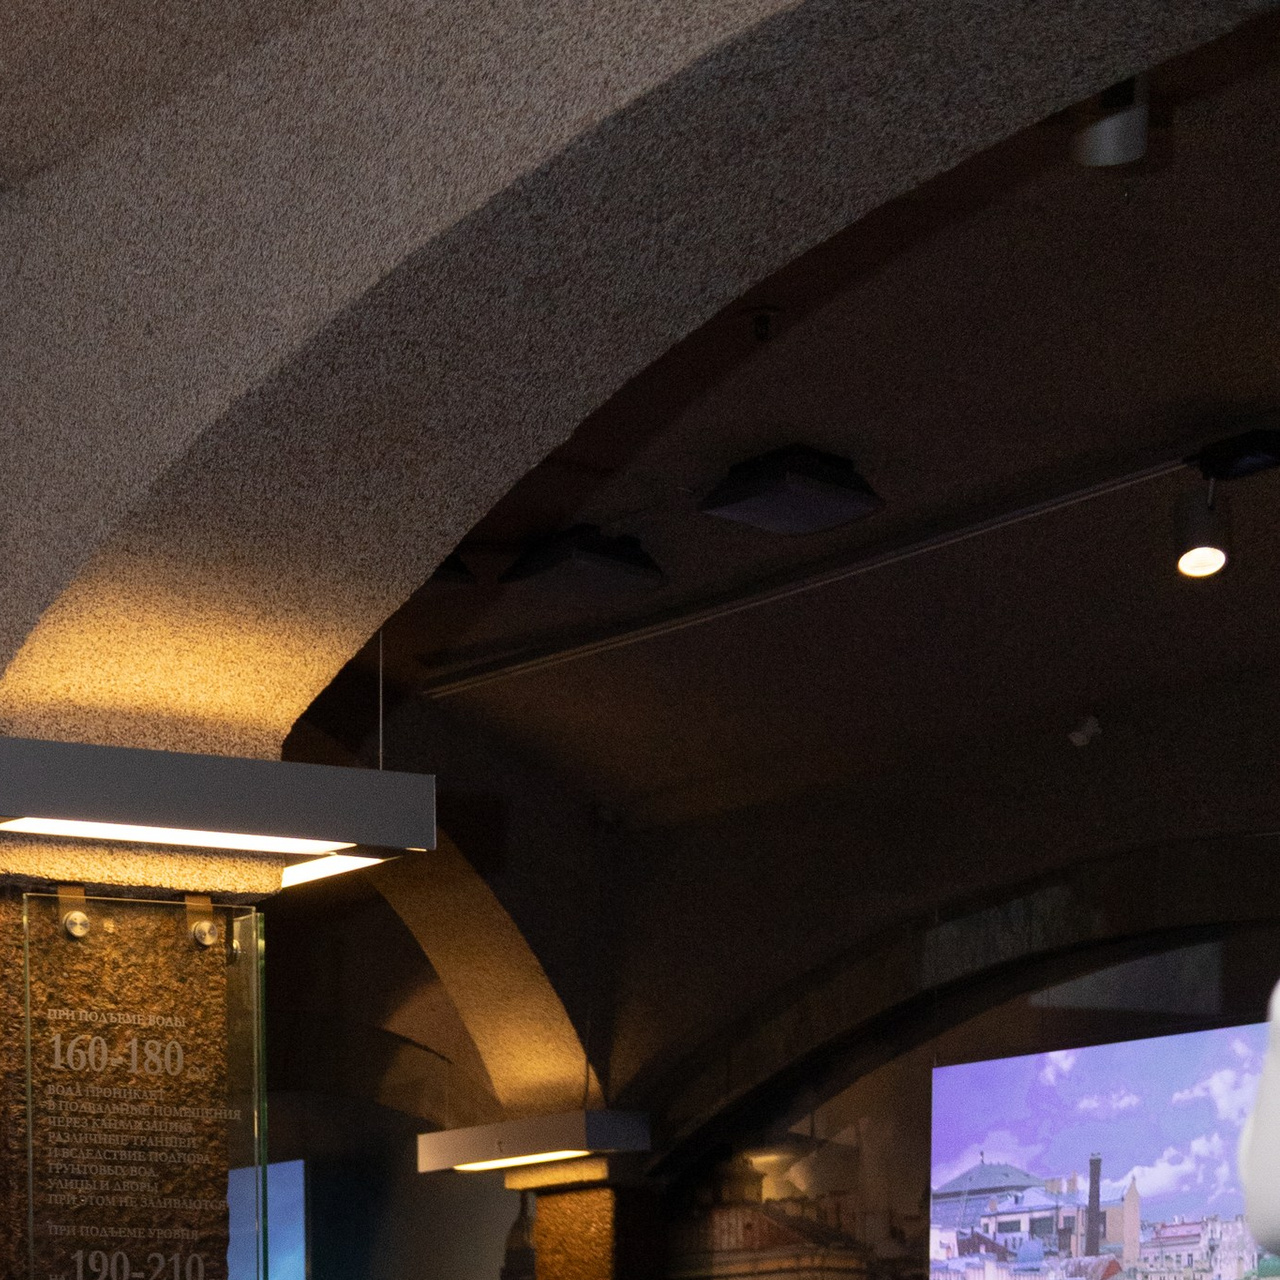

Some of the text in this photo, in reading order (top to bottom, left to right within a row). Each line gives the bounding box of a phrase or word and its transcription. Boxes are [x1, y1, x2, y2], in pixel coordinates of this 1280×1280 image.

[47, 1008, 186, 1028] ПРИ ПОДЪЕМЕ ВОДЫ
[48, 1033, 184, 1076] 160-180
[47, 1084, 166, 1101] ВОДА ПРОНИКАЕТ
[153, 1106, 242, 1121] ПОМЕЩЕНИЯ
[48, 1116, 89, 1128] ЧЕРЕЗ
[48, 1132, 129, 1146] РАЗЛИЧНЫЕ
[61, 1148, 147, 1161] ВСЛЕДСТВИЕ
[48, 1162, 128, 1176] ГРУНТОВЫХ
[48, 1177, 159, 1192] УЛИЦЫ И ДВОРЫ
[48, 1194, 77, 1206] ПРИ
[79, 1194, 116, 1207] ЭТОМ
[48, 1224, 199, 1240] ПРИ ПОДЪЕМЕ УРОВНЯ
